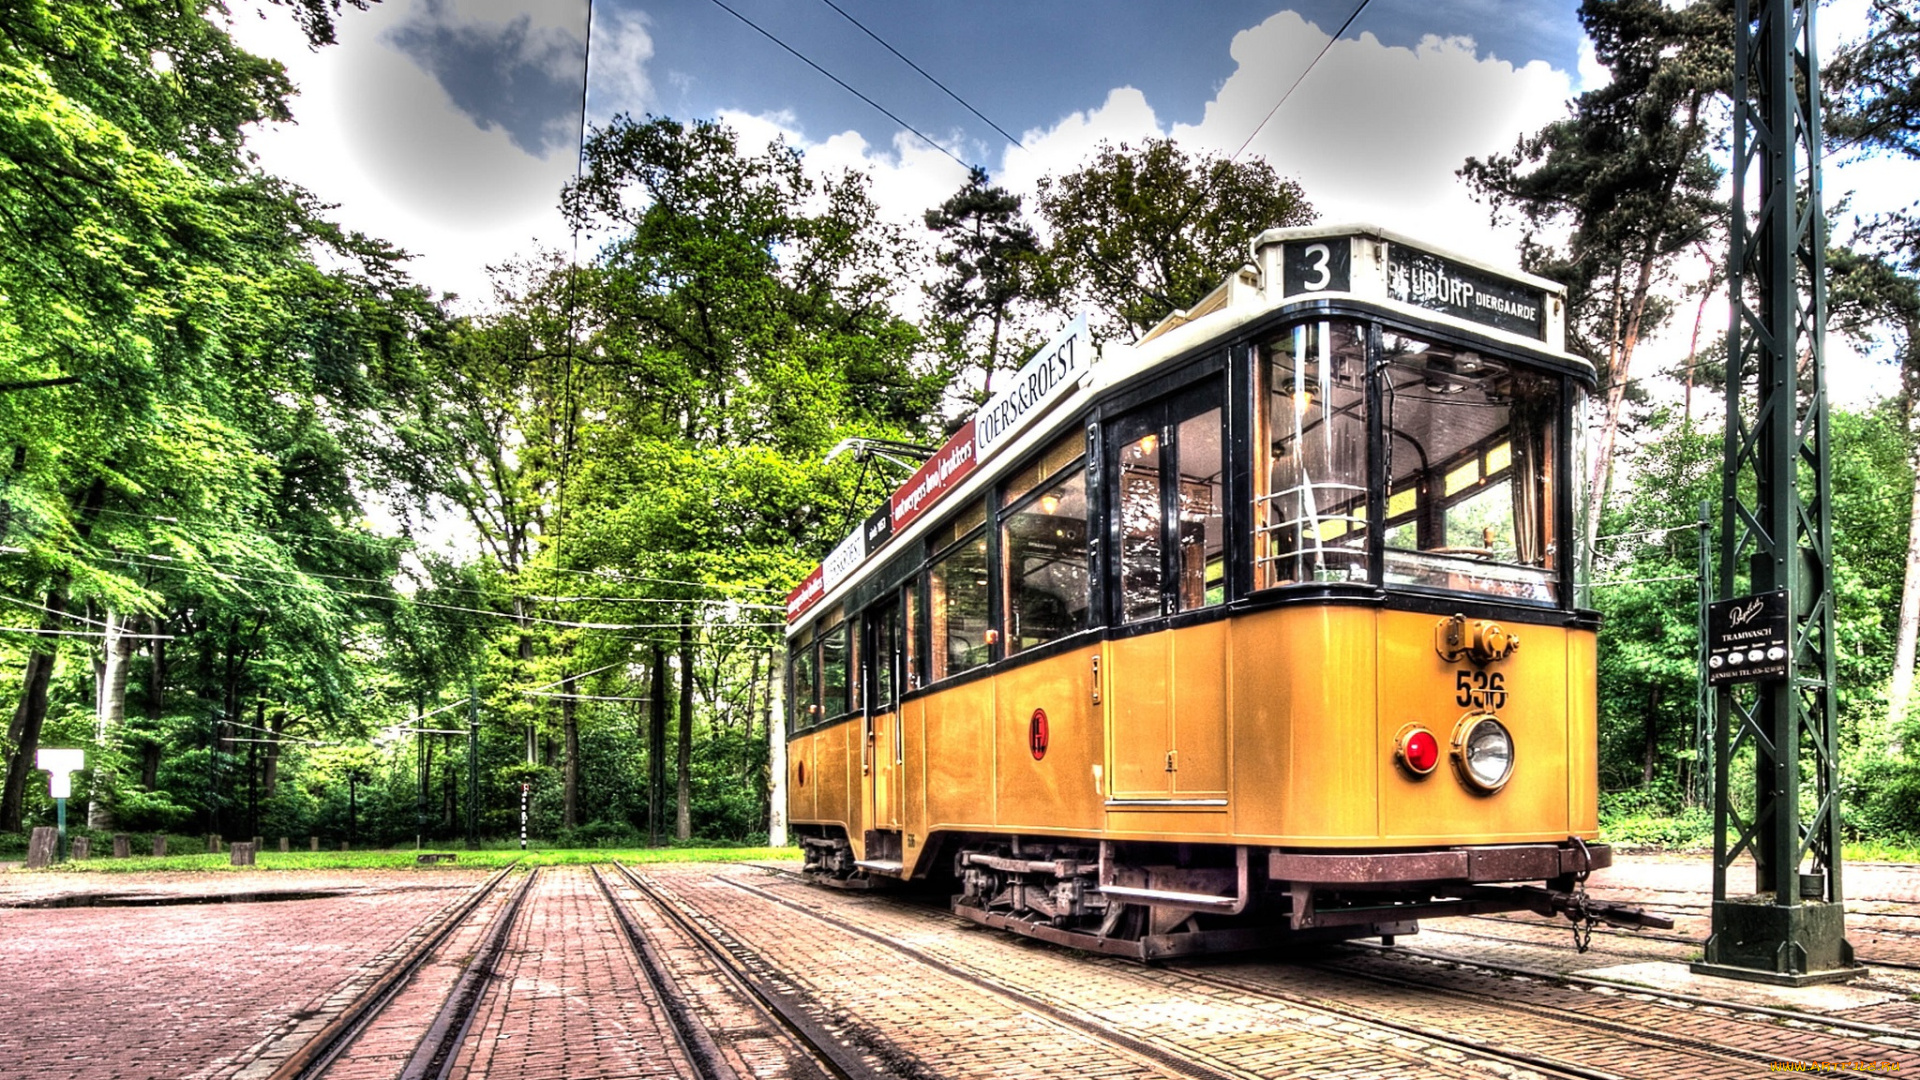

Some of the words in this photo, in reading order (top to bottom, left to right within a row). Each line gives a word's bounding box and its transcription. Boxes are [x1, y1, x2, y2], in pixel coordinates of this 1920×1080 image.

[1303, 243, 1331, 291] 3
[1475, 292, 1537, 322] DIERGAARDE
[977, 332, 1078, 450] COERS&ROEST
[1722, 628, 1772, 642] TRAMWASCH
[1455, 670, 1507, 710] 536
